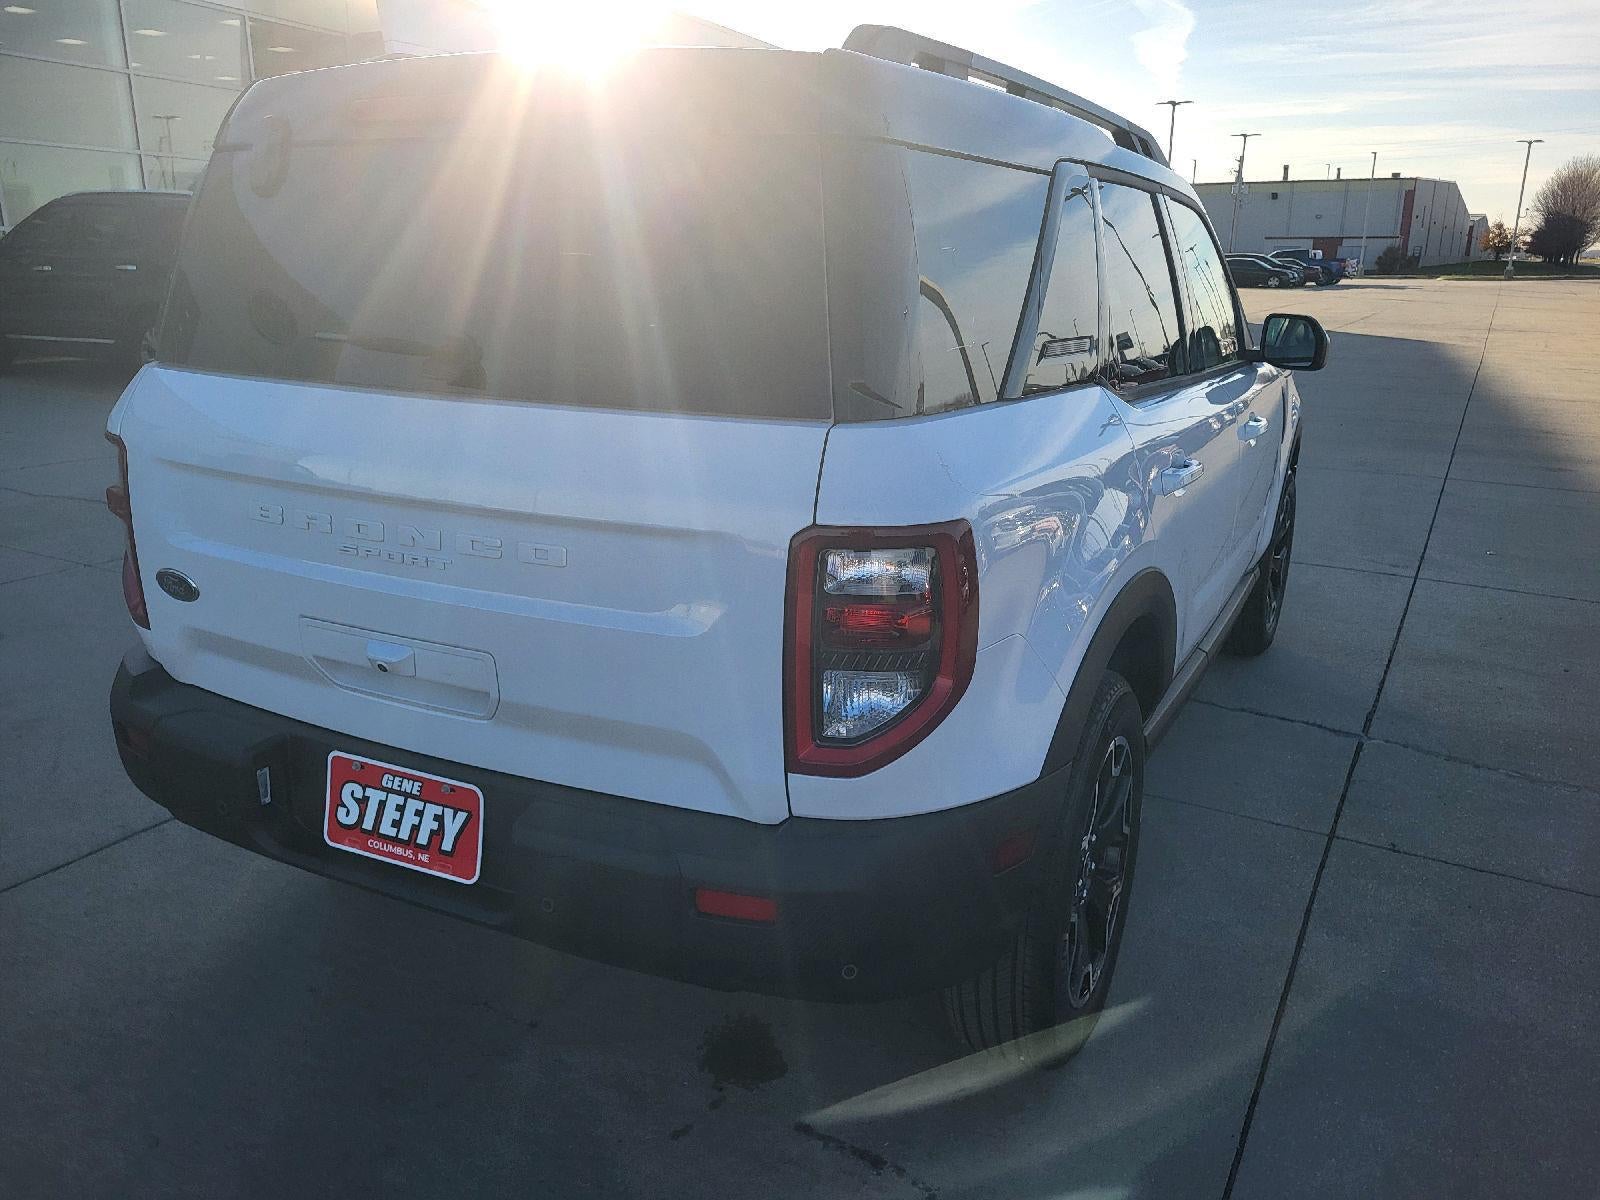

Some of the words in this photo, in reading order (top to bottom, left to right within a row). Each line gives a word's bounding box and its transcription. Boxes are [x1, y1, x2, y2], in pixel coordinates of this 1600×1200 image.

[250, 503, 568, 568] BRONCO
[339, 544, 453, 571] SPORT
[381, 773, 423, 796] GENE
[337, 782, 471, 853] STEFFY
[367, 839, 415, 861] COLUMBUS,
[417, 853, 431, 863] NE
